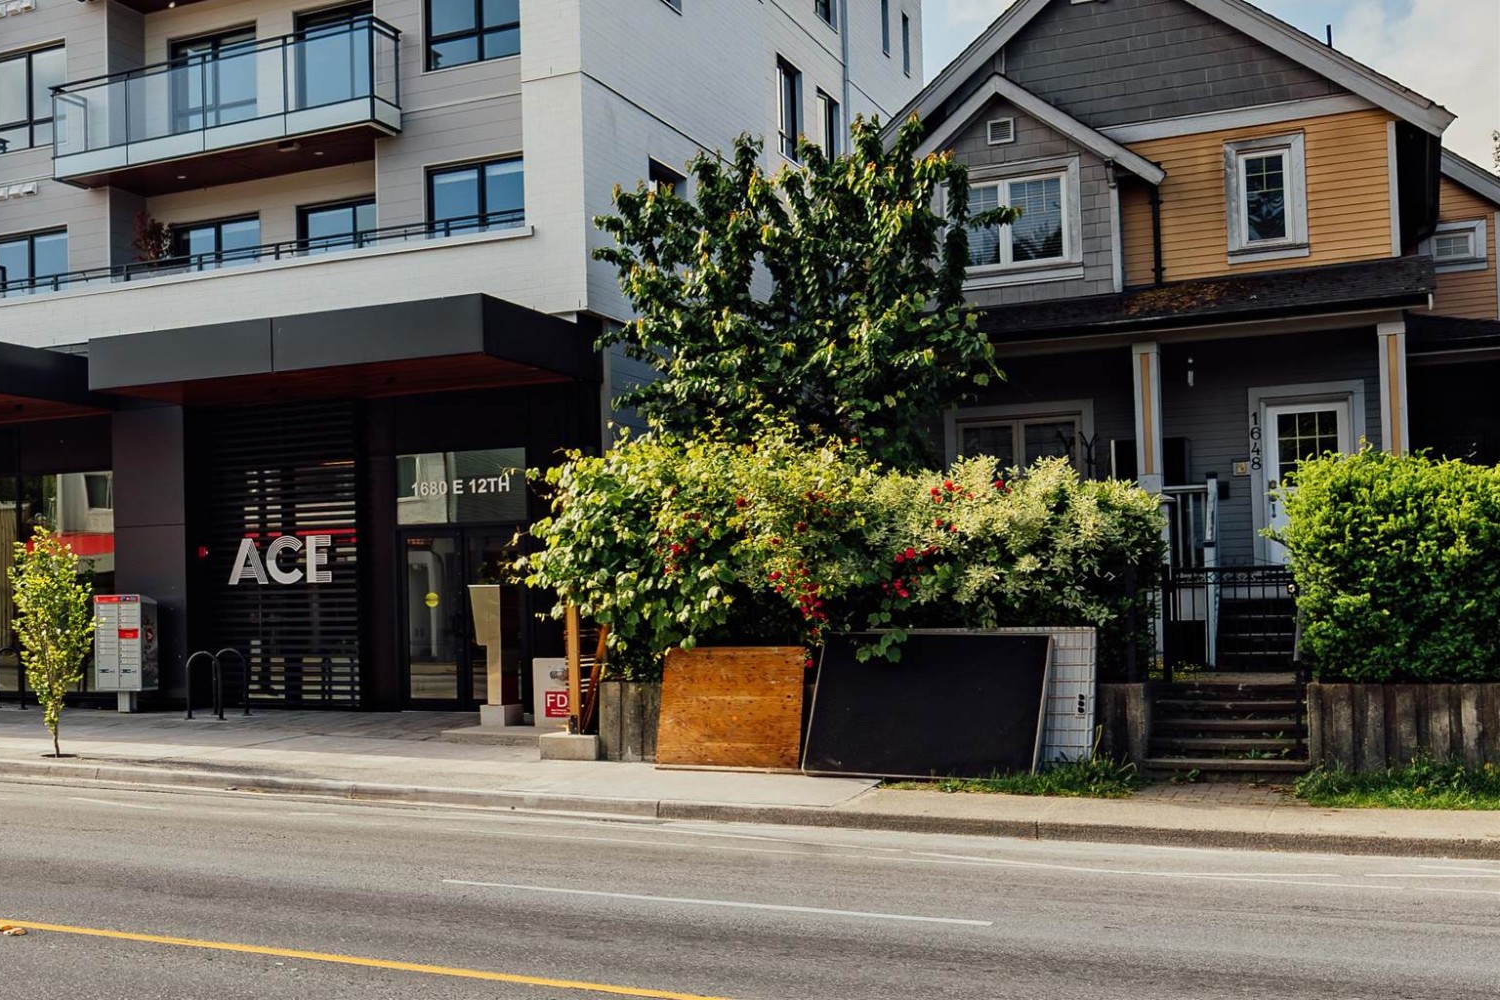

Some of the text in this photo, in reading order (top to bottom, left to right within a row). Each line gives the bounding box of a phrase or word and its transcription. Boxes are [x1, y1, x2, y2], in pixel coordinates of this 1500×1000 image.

[1251, 411, 1261, 470] 1648
[411, 473, 510, 497] 1680 E 12TH
[228, 535, 332, 585] ACE
[546, 694, 569, 708] FD
